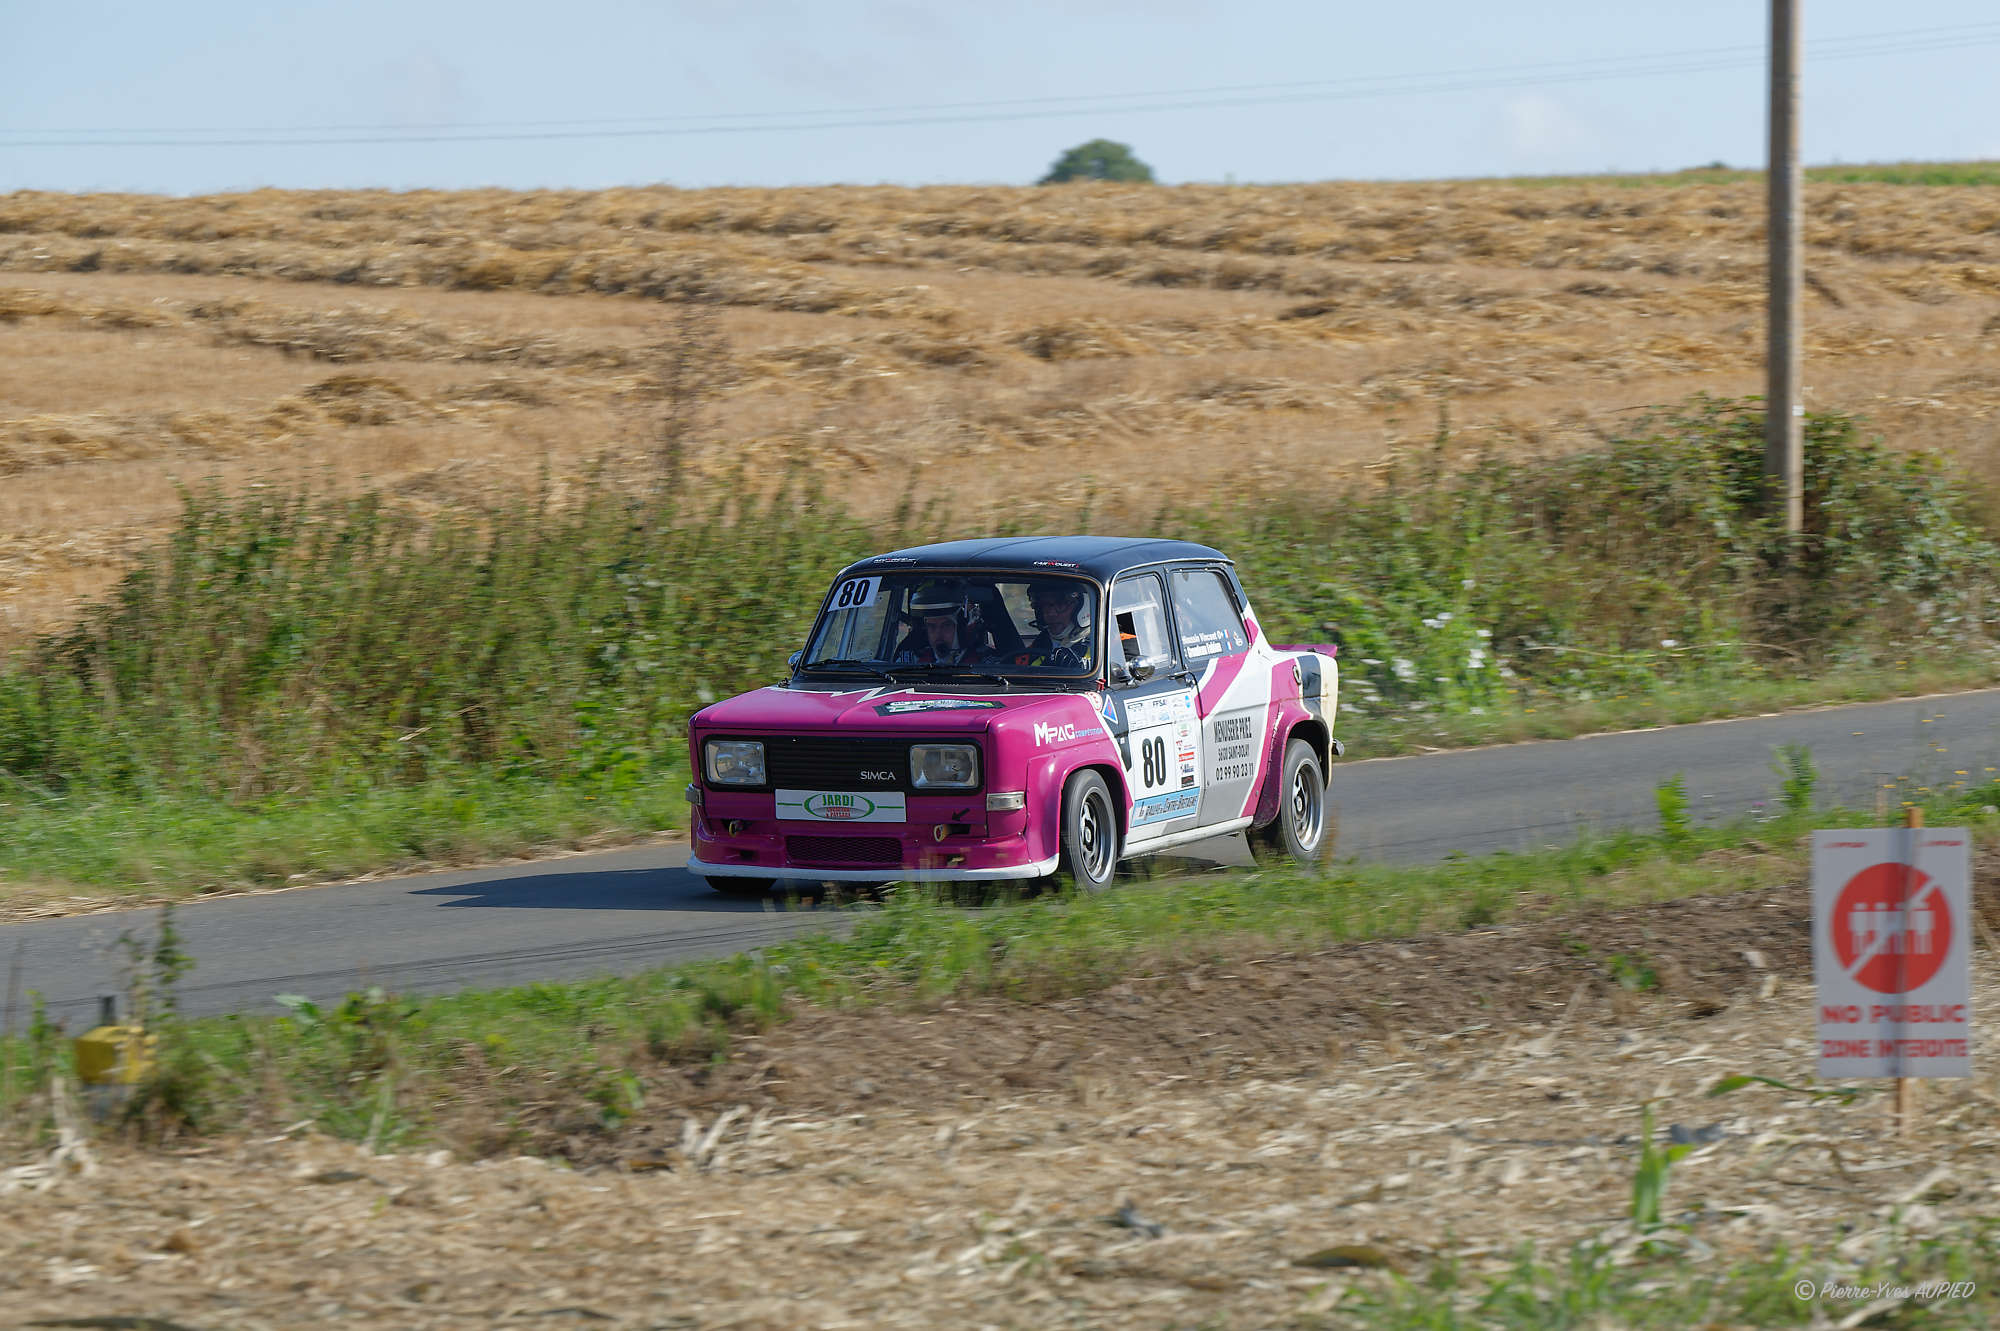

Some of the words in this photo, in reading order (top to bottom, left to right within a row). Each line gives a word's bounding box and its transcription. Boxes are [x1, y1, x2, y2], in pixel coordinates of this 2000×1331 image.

[838, 579, 871, 608] 80
[1142, 735, 1166, 789] 80
[1216, 767, 1223, 781] 02
[1224, 766, 1231, 779] 99
[1241, 763, 1248, 777] 23
[860, 770, 896, 781] SIMCA
[822, 794, 855, 807] JARDI
[1821, 1004, 1863, 1024] NO
[1869, 1004, 1966, 1024] PUBLIC
[1821, 1038, 1871, 1058] ZONE
